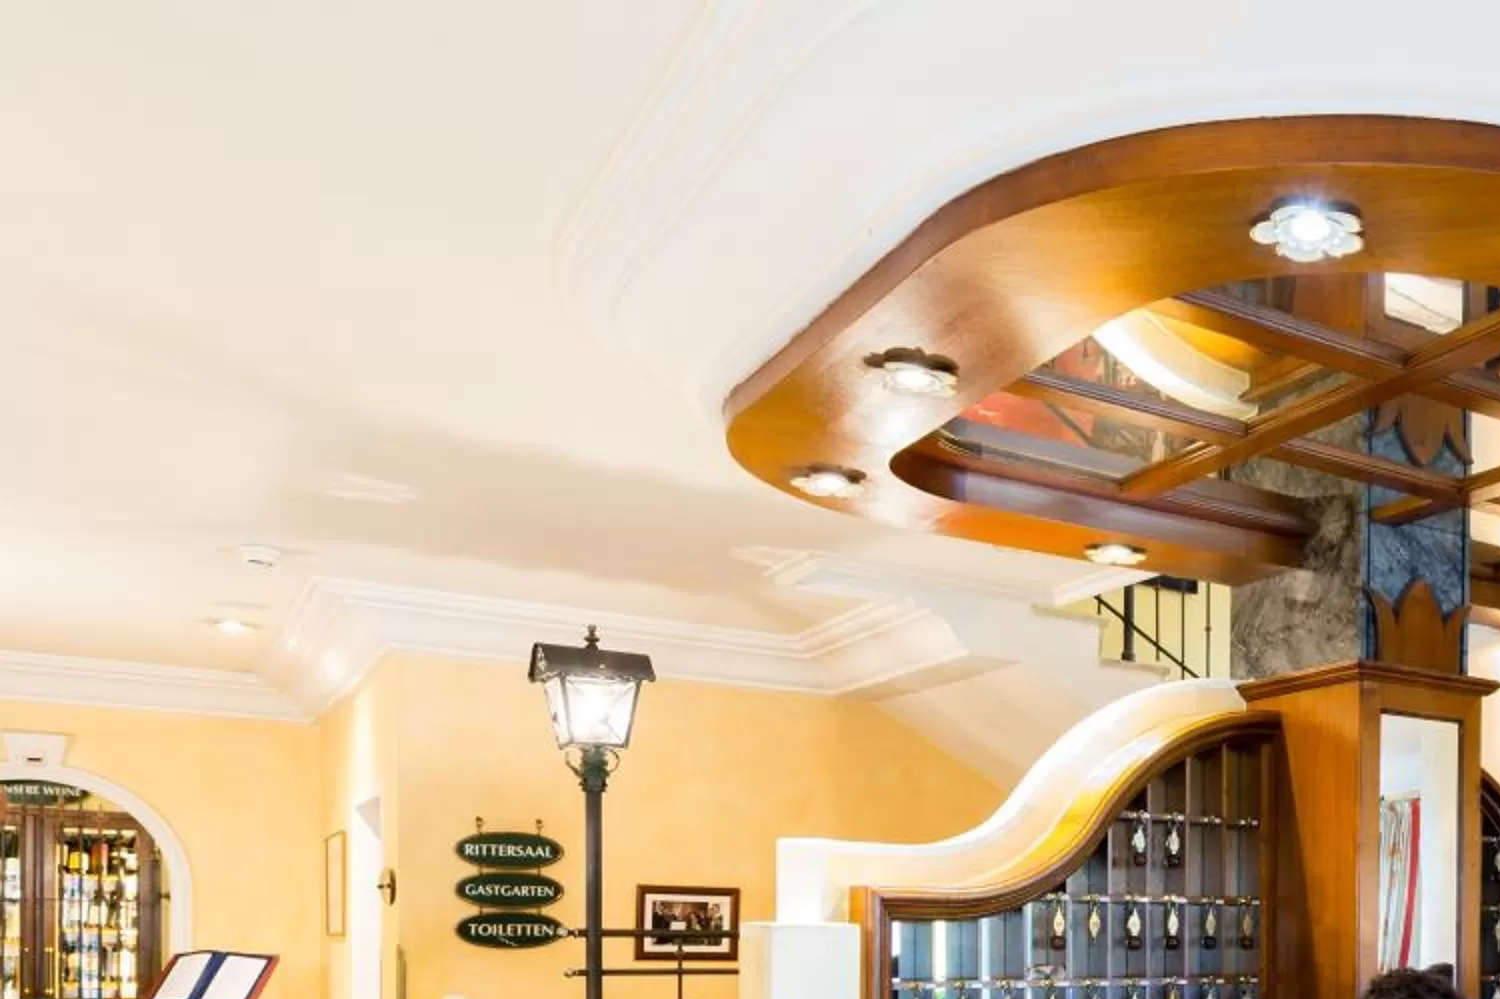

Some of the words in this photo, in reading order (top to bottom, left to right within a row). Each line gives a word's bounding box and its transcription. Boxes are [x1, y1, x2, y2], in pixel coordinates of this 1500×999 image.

[464, 843, 552, 858] RITTERSAAL
[464, 883, 555, 897] GASTGARTEN
[467, 923, 555, 937] TOILETTEN
